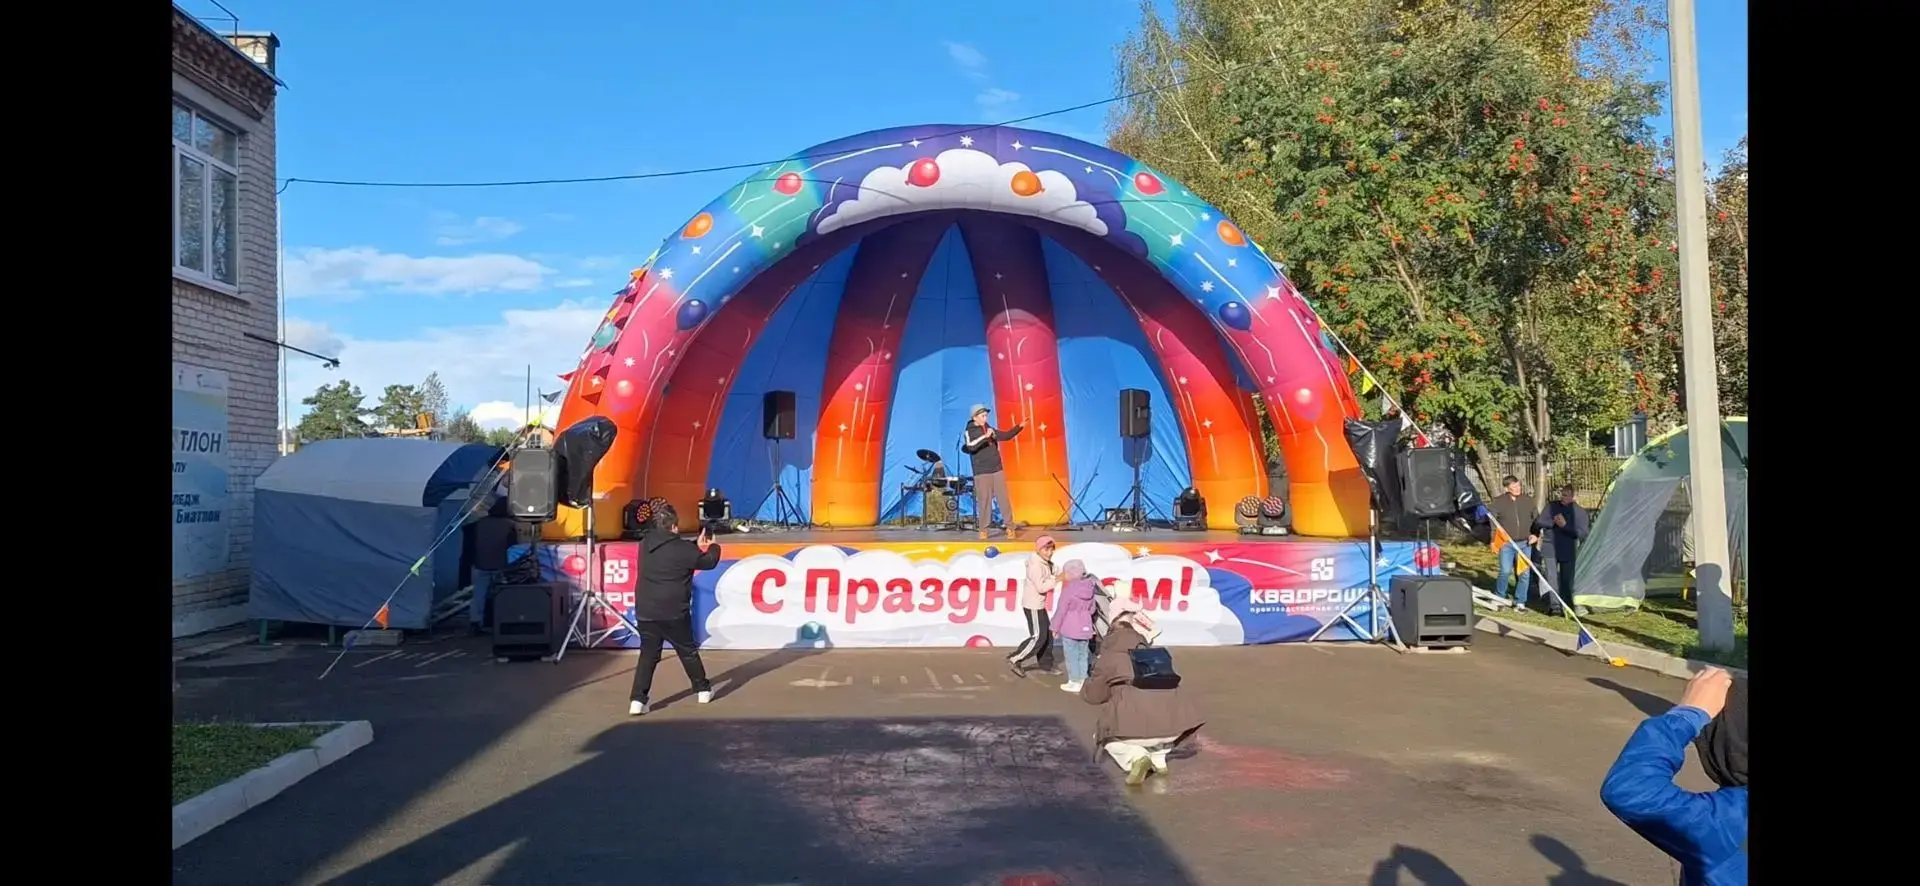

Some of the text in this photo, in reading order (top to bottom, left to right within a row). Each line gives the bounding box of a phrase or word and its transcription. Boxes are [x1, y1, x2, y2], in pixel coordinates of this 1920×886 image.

[180, 430, 222, 454] ТЛОН
[176, 508, 221, 524] Биатлон
[750, 566, 1194, 624] С Празднм!
